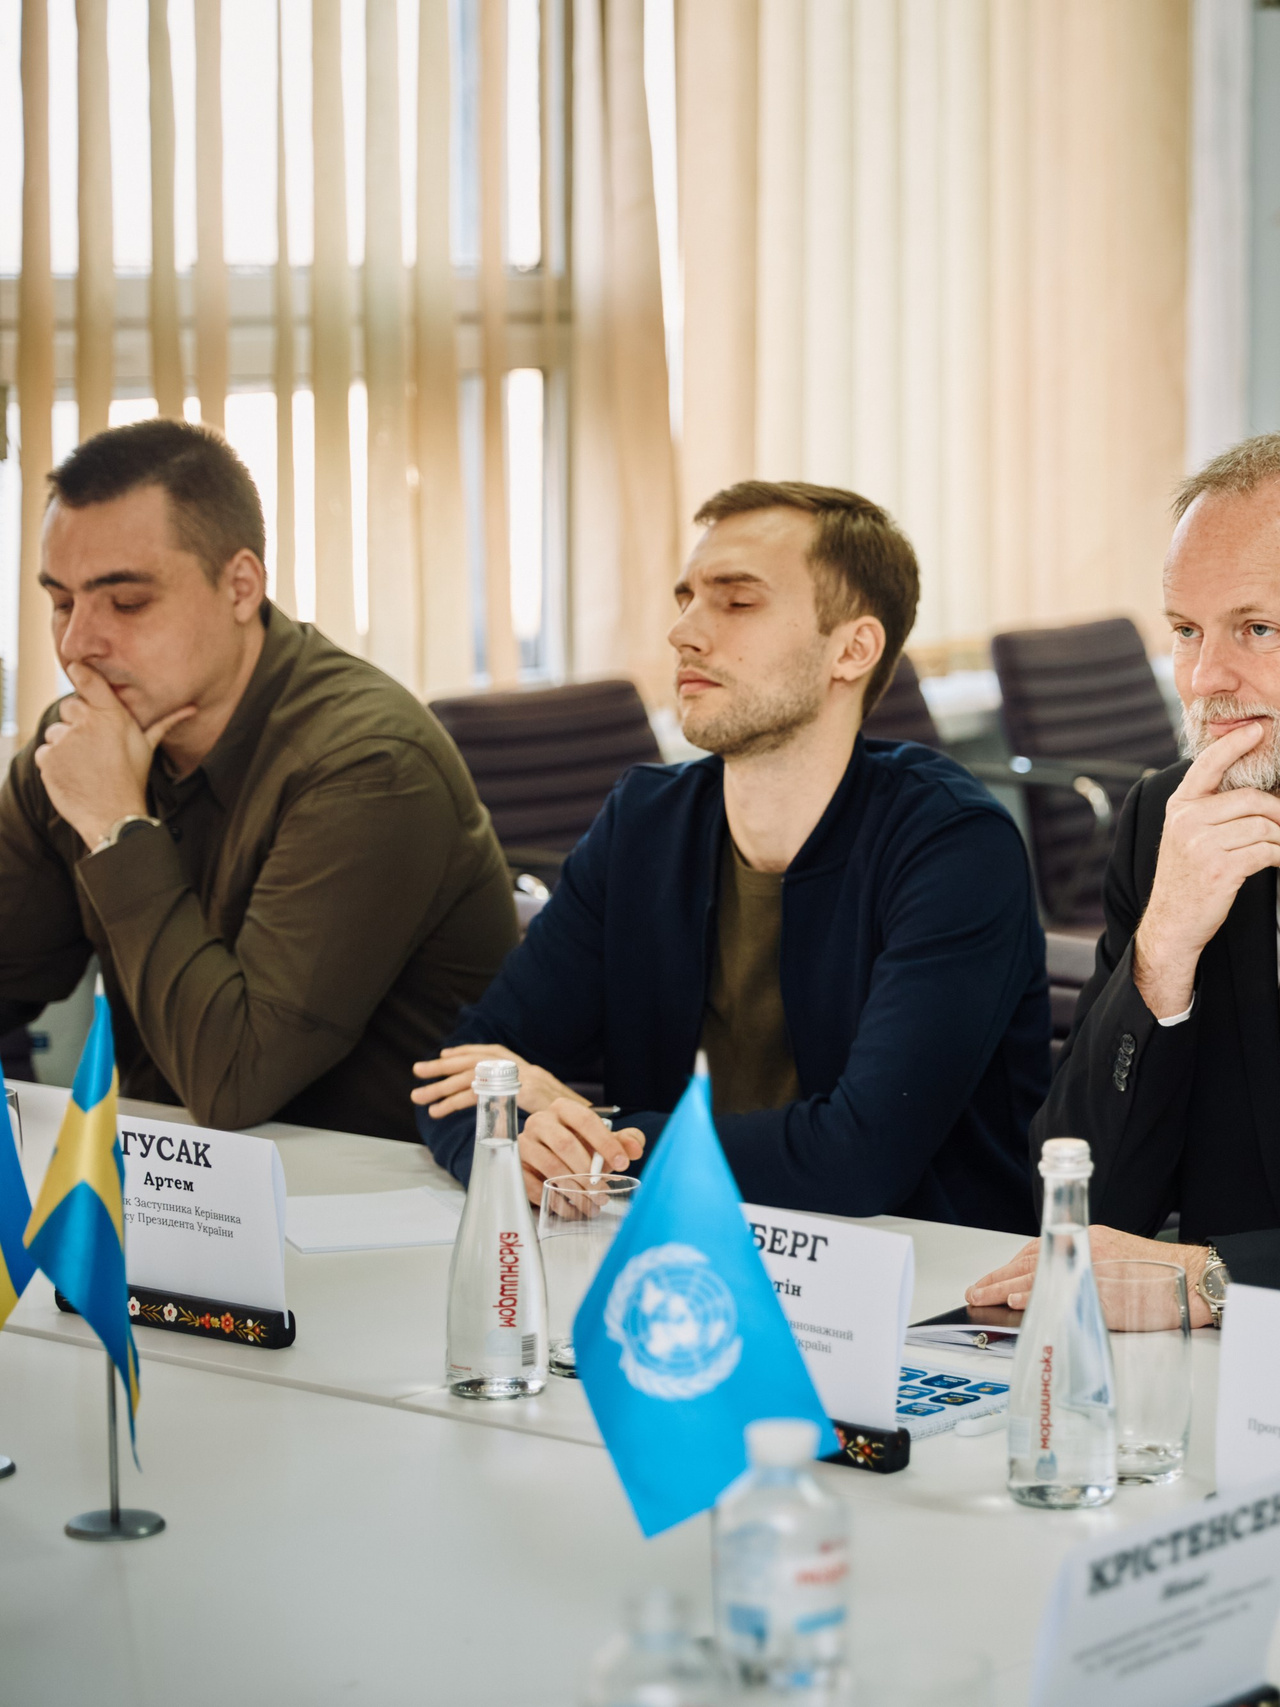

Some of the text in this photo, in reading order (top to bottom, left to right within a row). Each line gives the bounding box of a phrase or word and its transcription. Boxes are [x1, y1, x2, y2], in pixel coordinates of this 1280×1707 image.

[121, 1131, 212, 1168] ГУСАК
[143, 1171, 195, 1192] Артем
[134, 1197, 192, 1215] Заступника
[194, 1205, 242, 1225] Керівника
[137, 1212, 195, 1231] Президента
[197, 1221, 234, 1239] України
[749, 1222, 829, 1262] БЕРГ
[773, 1278, 802, 1297] тін
[789, 1319, 854, 1341] вноважний
[794, 1335, 832, 1354] країні
[1038, 1345, 1053, 1450] моршинська
